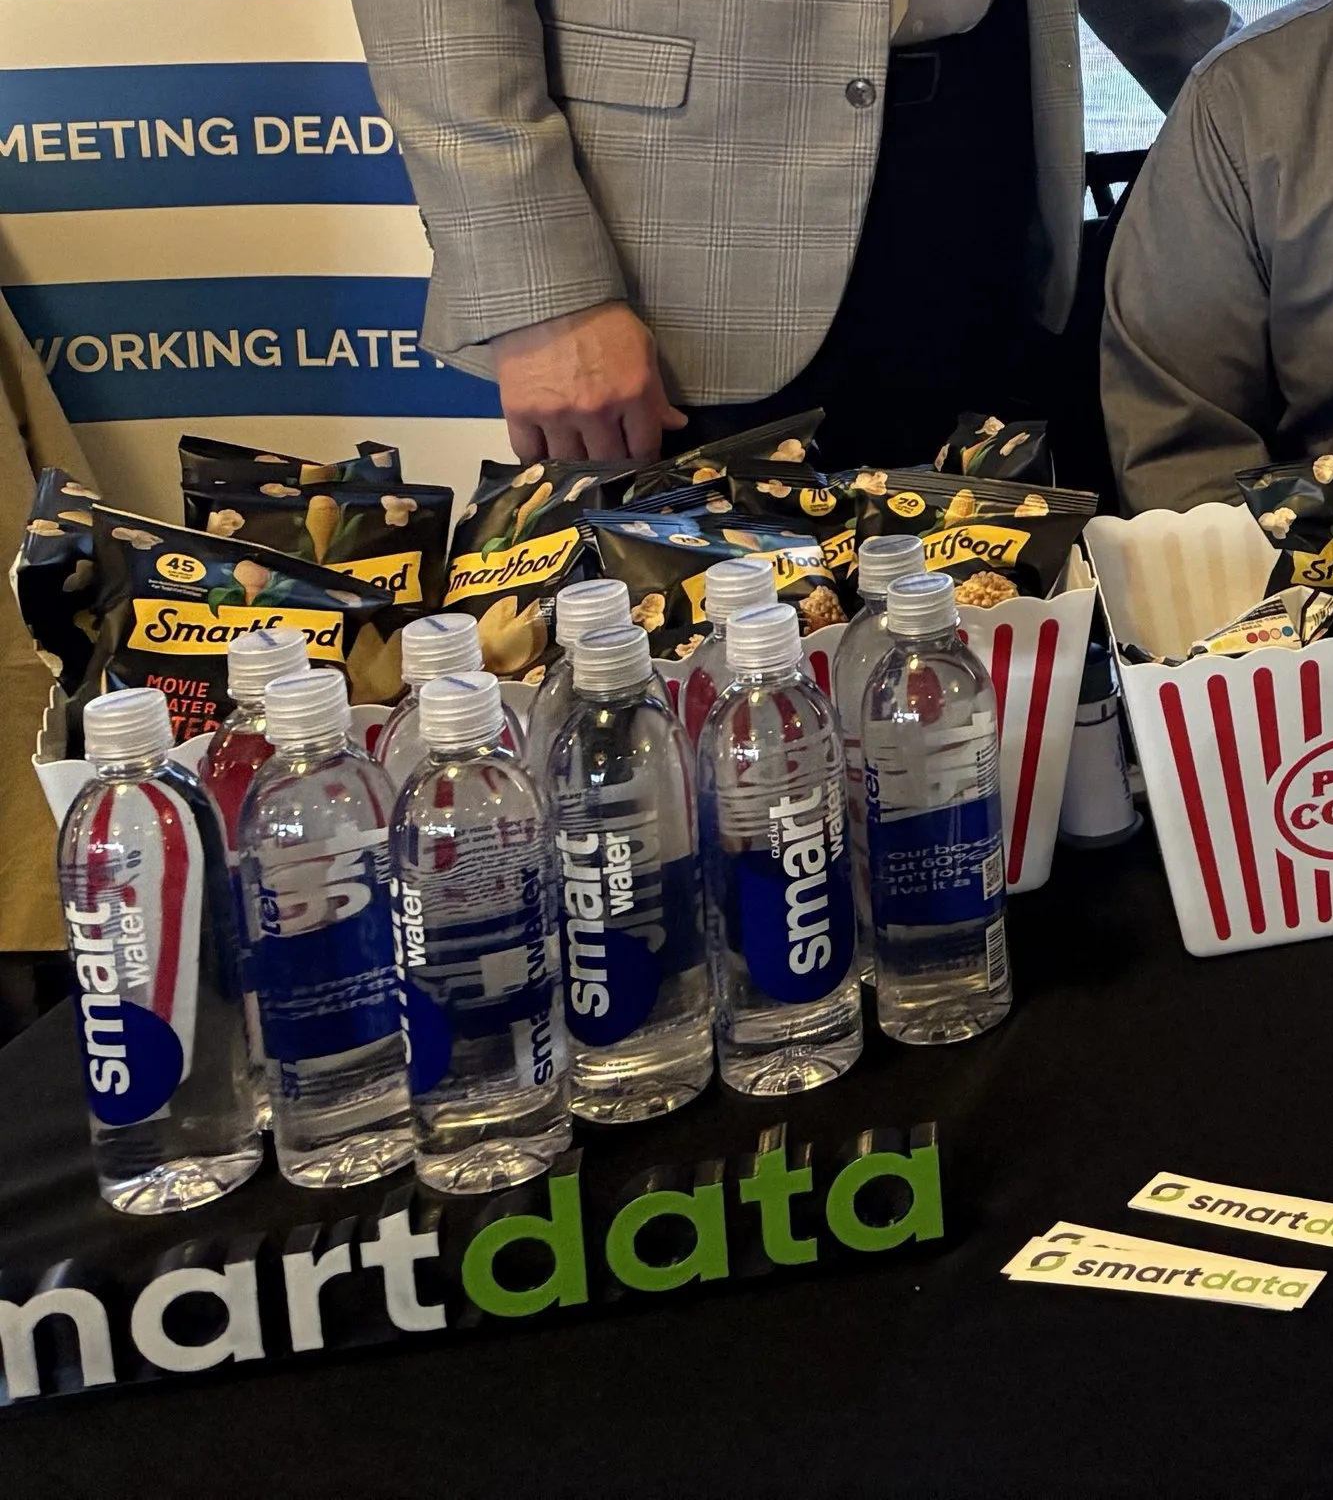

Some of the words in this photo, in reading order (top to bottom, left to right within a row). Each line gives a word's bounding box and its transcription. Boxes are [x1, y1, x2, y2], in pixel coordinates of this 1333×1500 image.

[255, 116, 403, 156] DEAD
[297, 328, 420, 368] LATE
[165, 557, 196, 574] 45
[145, 608, 342, 647] Smartfod
[147, 675, 209, 697] MOVIE
[769, 786, 831, 975] smart
[402, 882, 427, 967] water
[555, 831, 609, 1018] smart
[602, 831, 635, 918] water
[68, 901, 129, 1095] smart
[113, 901, 150, 989] water
[1072, 1257, 1308, 1298] smartdata
